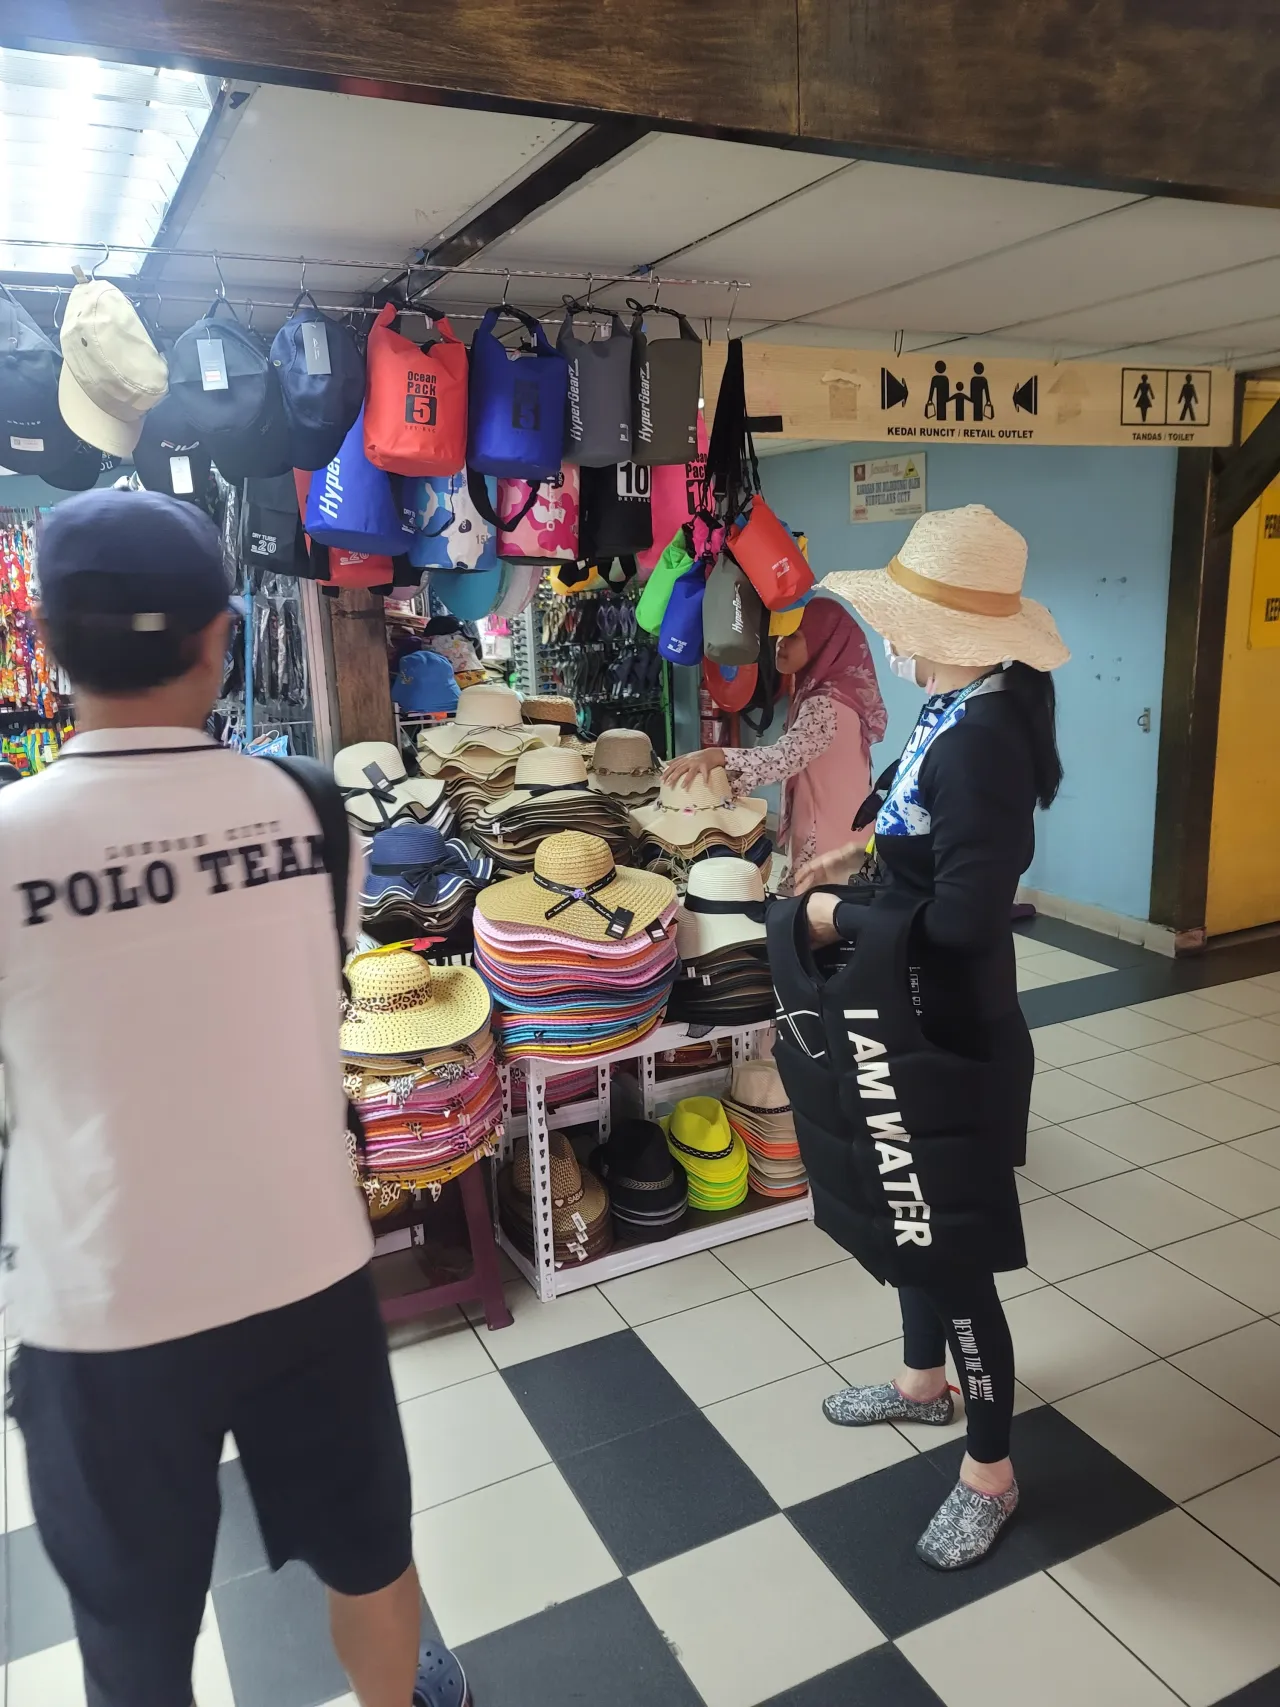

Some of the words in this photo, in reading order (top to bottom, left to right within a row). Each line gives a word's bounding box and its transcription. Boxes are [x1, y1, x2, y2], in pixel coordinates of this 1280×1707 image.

[407, 370, 437, 384] Ocean
[407, 381, 436, 396] Pack
[413, 397, 431, 423] 5
[567, 358, 583, 441] HyperGear
[638, 361, 653, 443] HyperGear
[887, 427, 917, 436] KEDAI
[919, 427, 956, 438] RUNCIT
[963, 428, 996, 438] RETAIL
[998, 429, 1034, 439] OUTLET
[1132, 432, 1162, 441] TANDAS
[1168, 433, 1195, 441] TOILET
[619, 461, 649, 495] 10
[686, 464, 707, 479] Pac
[258, 539, 277, 554] 20
[15, 860, 175, 926] POLO
[843, 1009, 879, 1019] I
[847, 1031, 897, 1100] AM
[866, 1111, 933, 1247] WATER
[951, 1318, 979, 1354] BEYOND
[963, 1356, 984, 1373] THE
